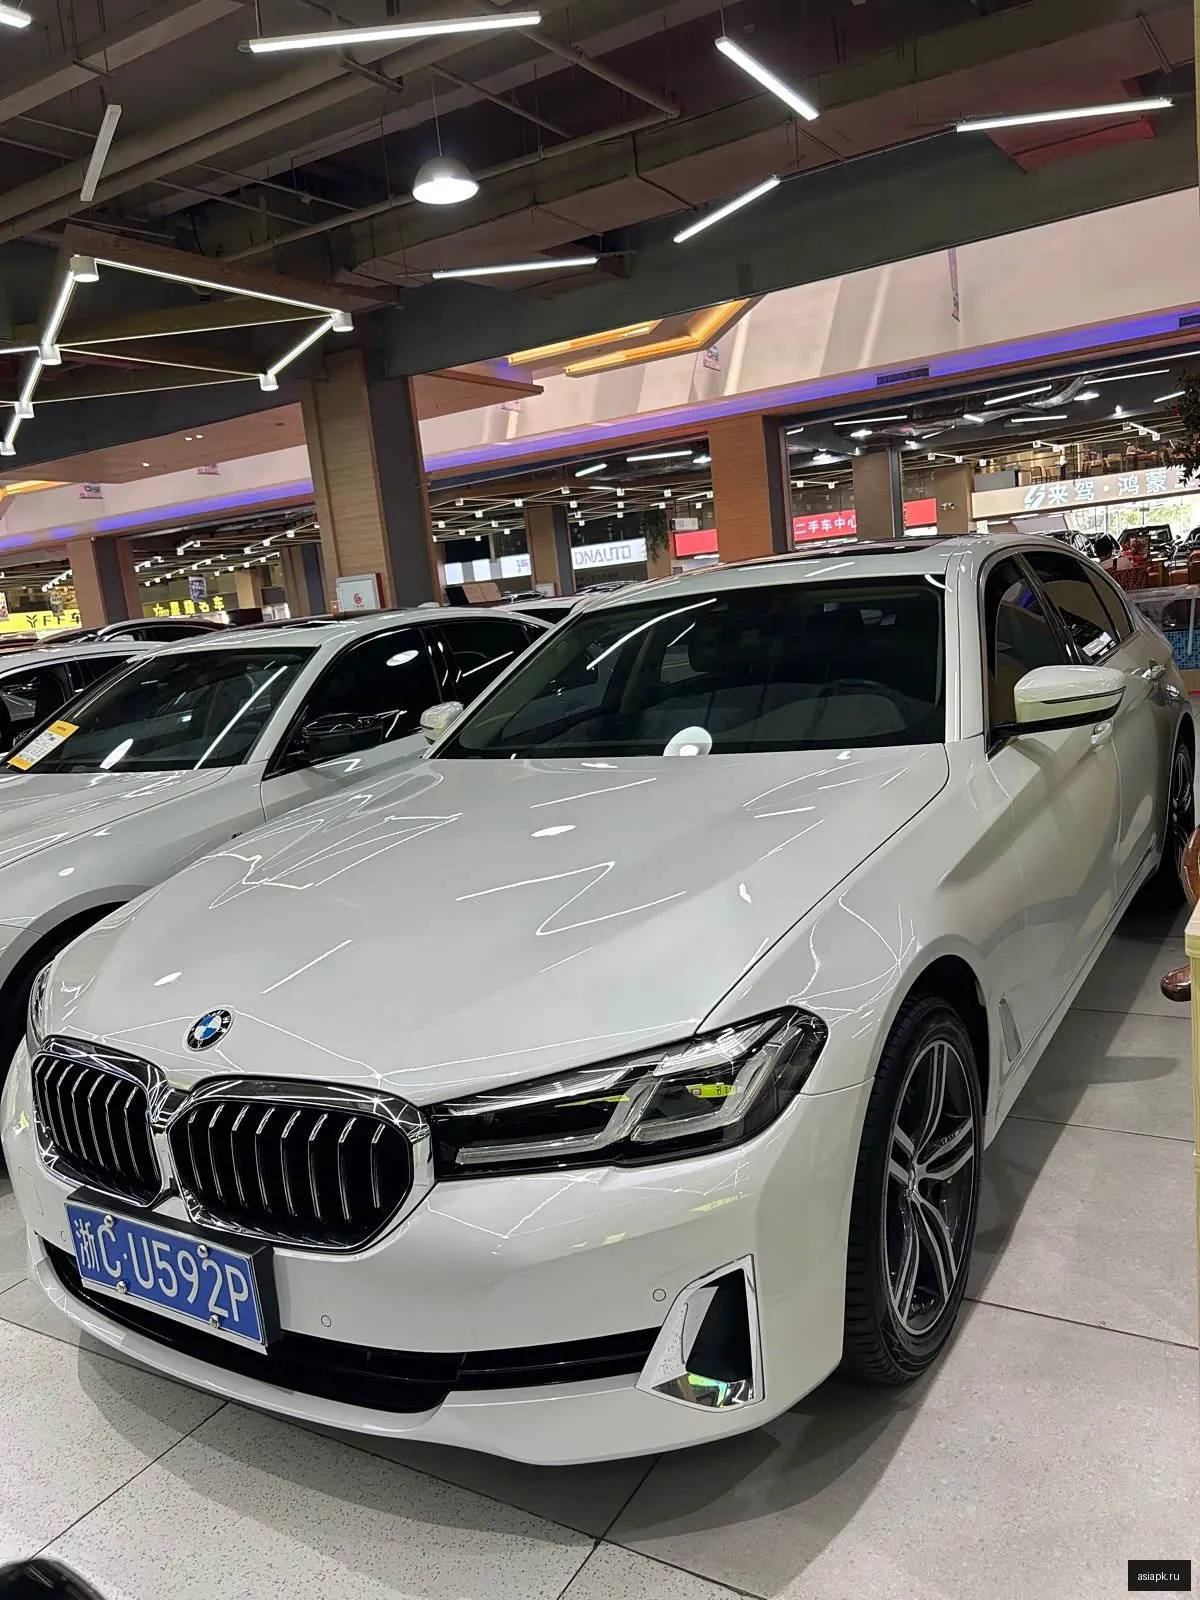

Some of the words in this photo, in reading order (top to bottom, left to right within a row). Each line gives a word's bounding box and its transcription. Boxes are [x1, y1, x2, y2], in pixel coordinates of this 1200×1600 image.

[794, 514, 858, 535] 二手车中心
[575, 545, 632, 566] DNAUTO
[74, 1218, 249, 1322] 浙C·U592P
